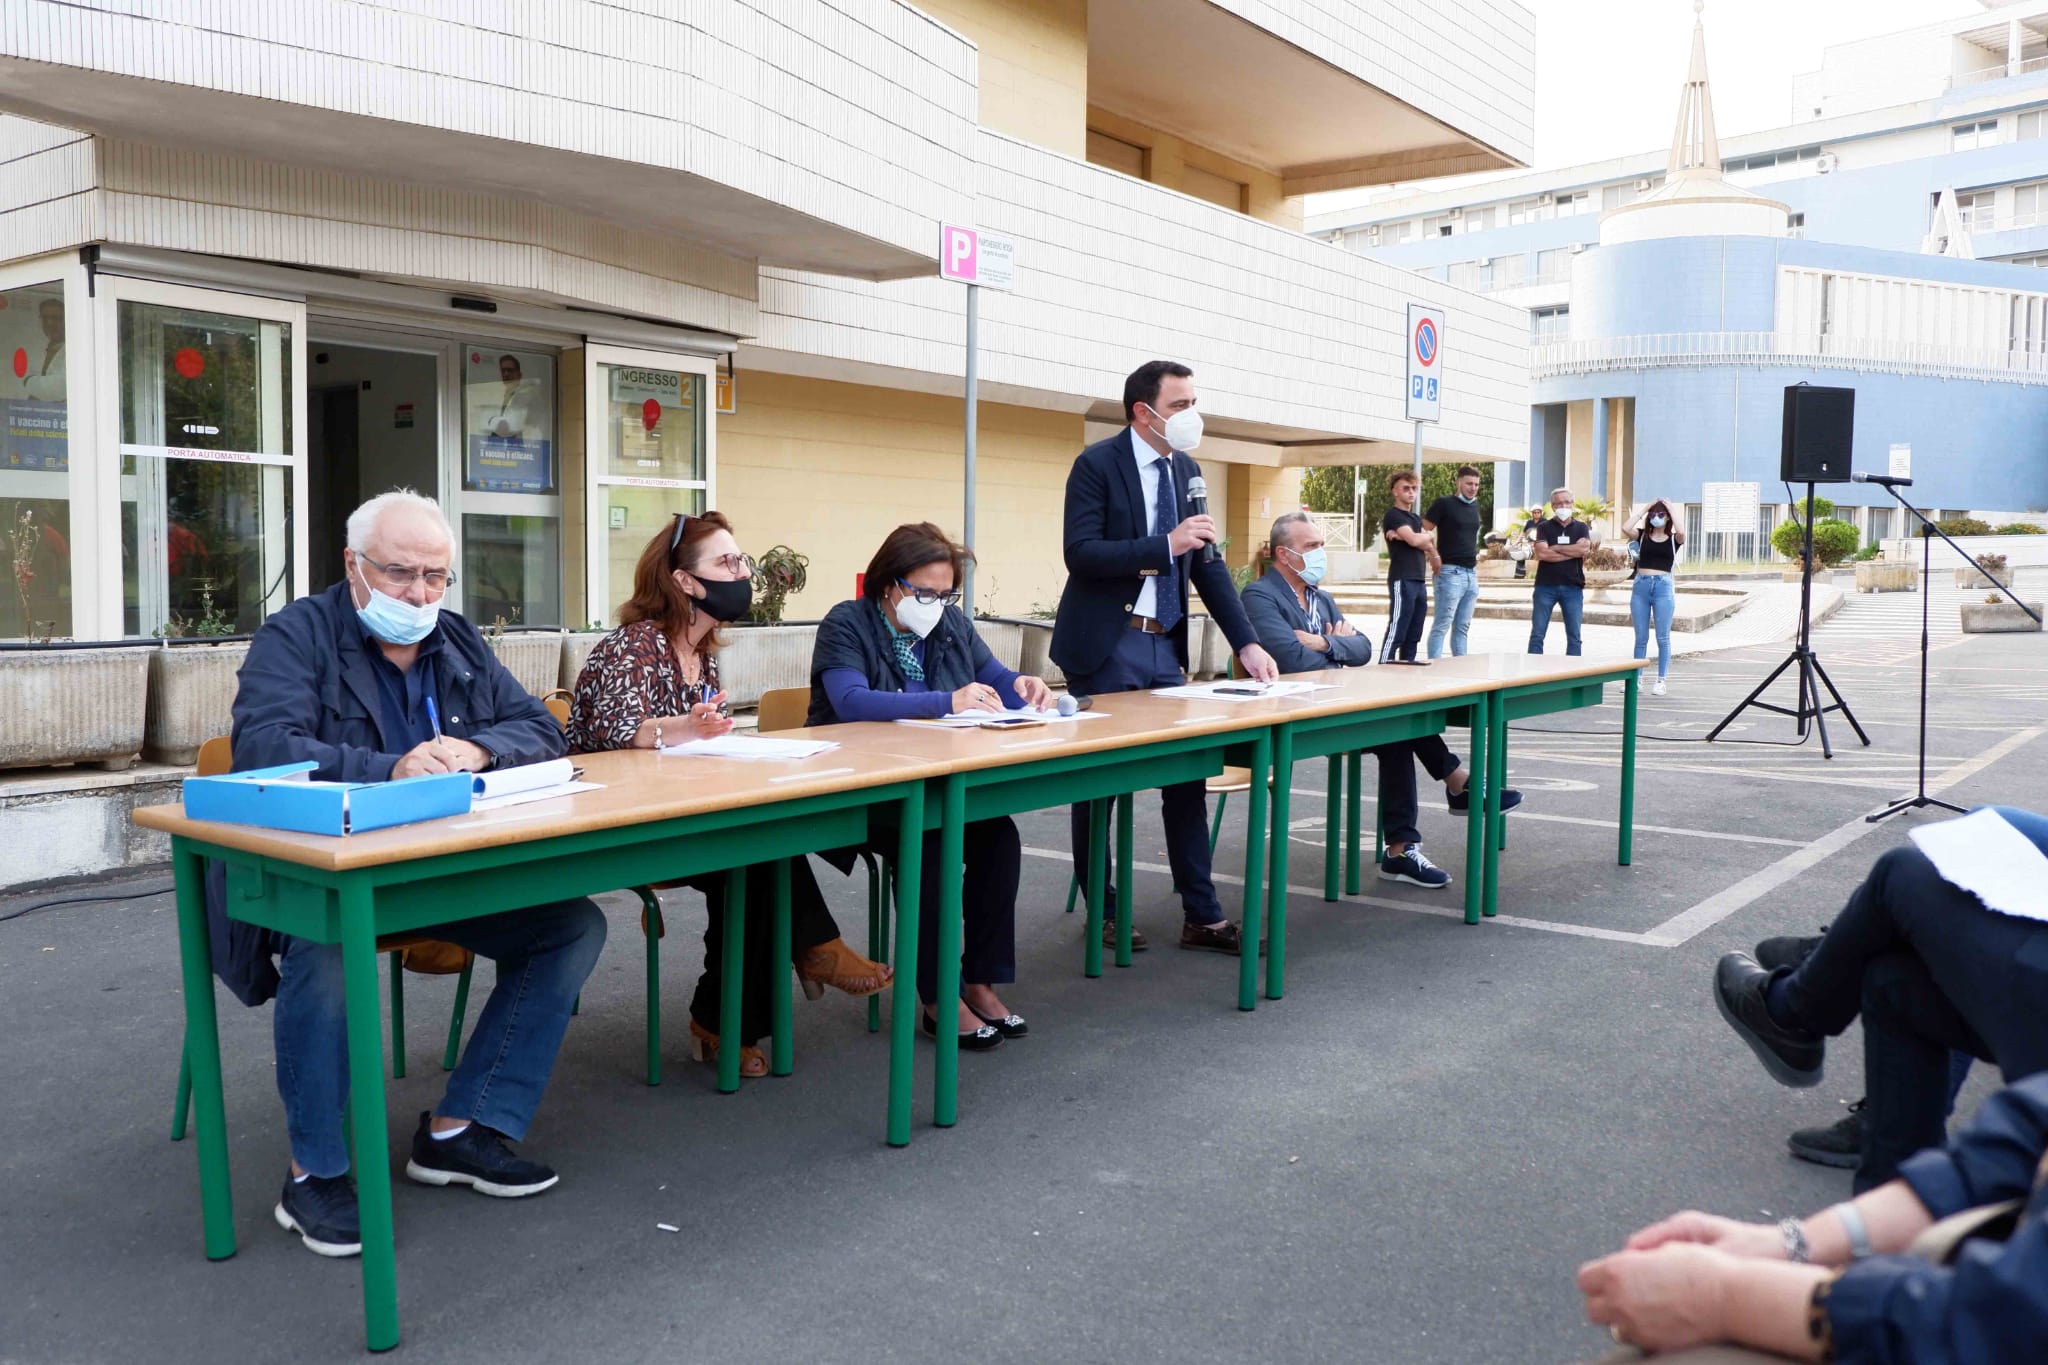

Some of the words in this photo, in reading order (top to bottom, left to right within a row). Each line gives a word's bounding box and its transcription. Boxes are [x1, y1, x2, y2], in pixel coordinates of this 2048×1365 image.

[951, 230, 972, 272] P
[618, 367, 678, 387] INGRESSO
[1414, 377, 1422, 395] P
[682, 377, 692, 399] 2
[17, 417, 51, 429] vaccino
[168, 448, 196, 457] PORTA
[198, 451, 251, 461] AUTOMATICA
[645, 479, 679, 487] AUTOMATICA
